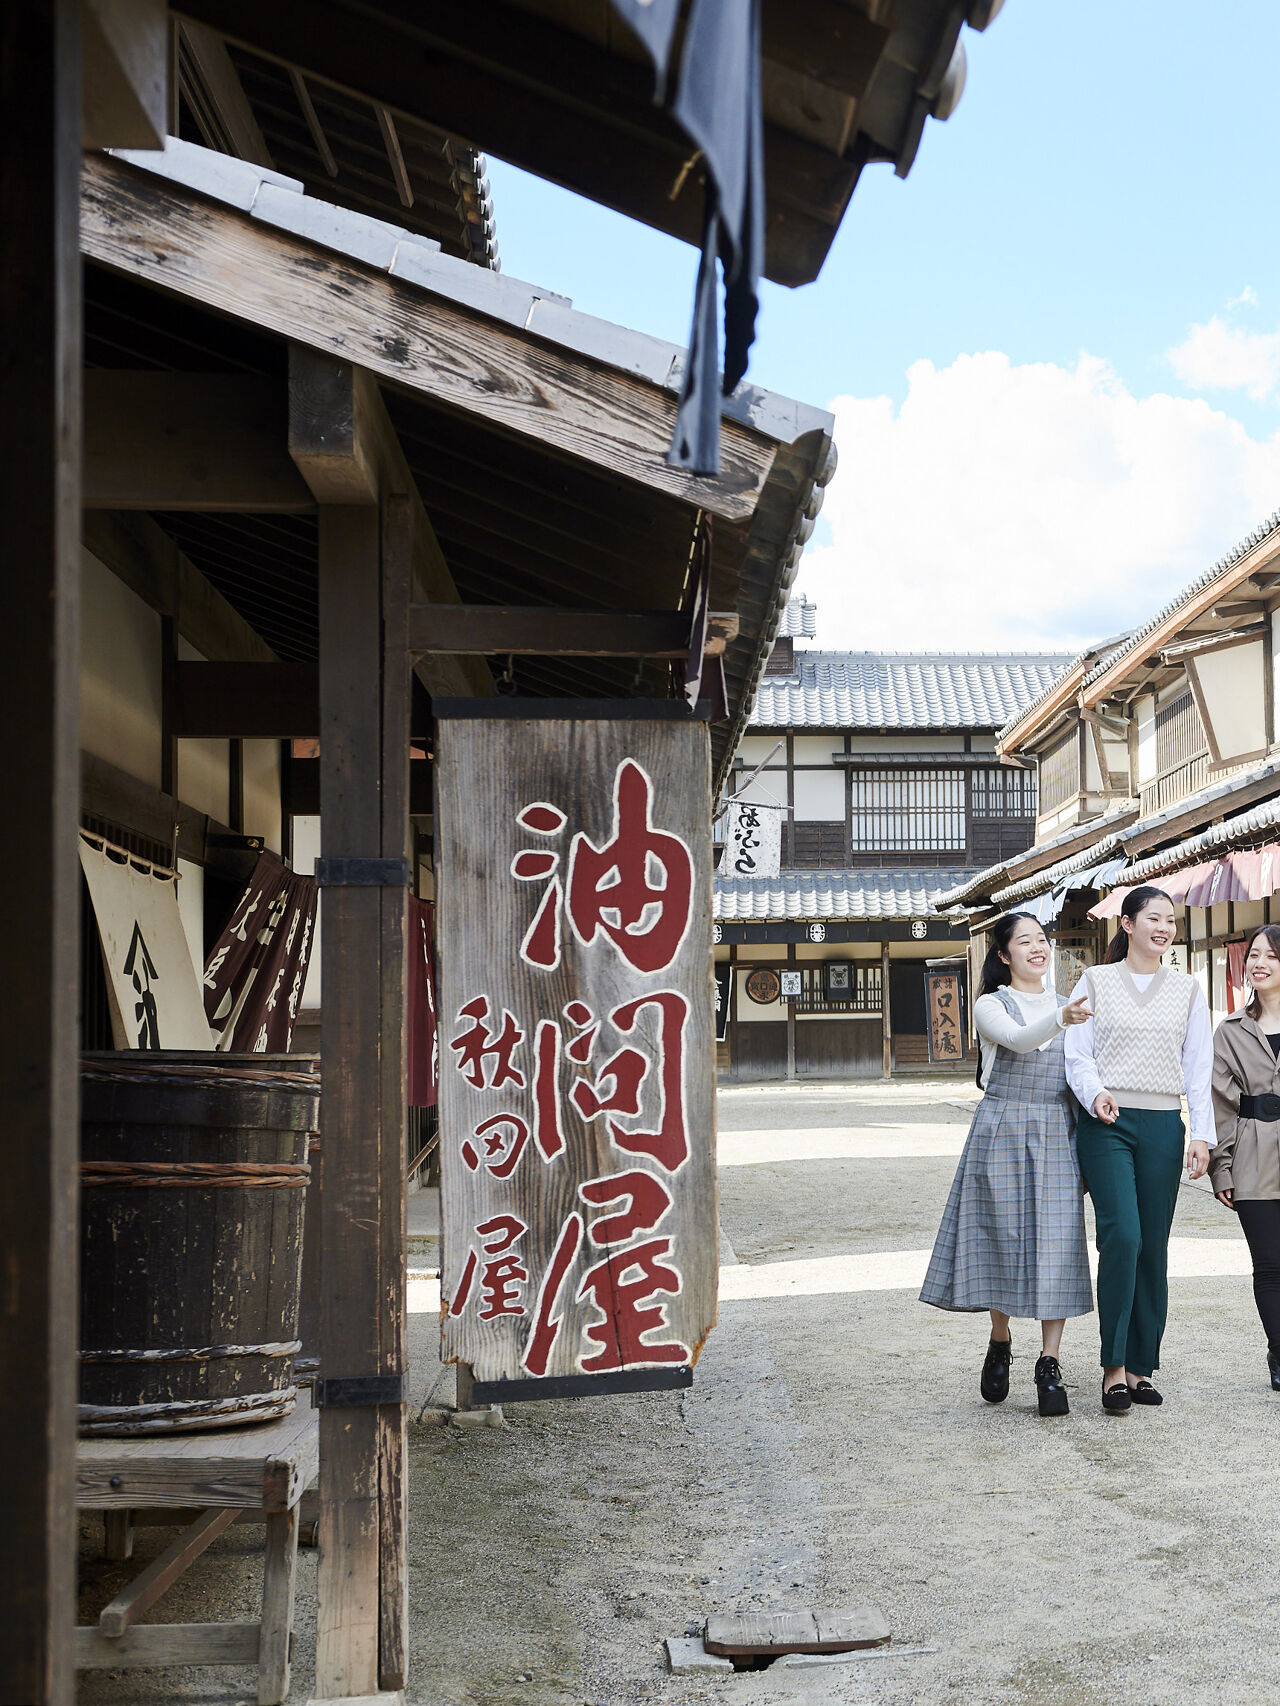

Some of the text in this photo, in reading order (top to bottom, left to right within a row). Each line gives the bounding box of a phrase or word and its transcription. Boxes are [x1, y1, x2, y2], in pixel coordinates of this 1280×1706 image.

[734, 806, 761, 874] あぶら
[449, 994, 528, 1323] 秋田屋
[509, 757, 696, 1378] 油問屋
